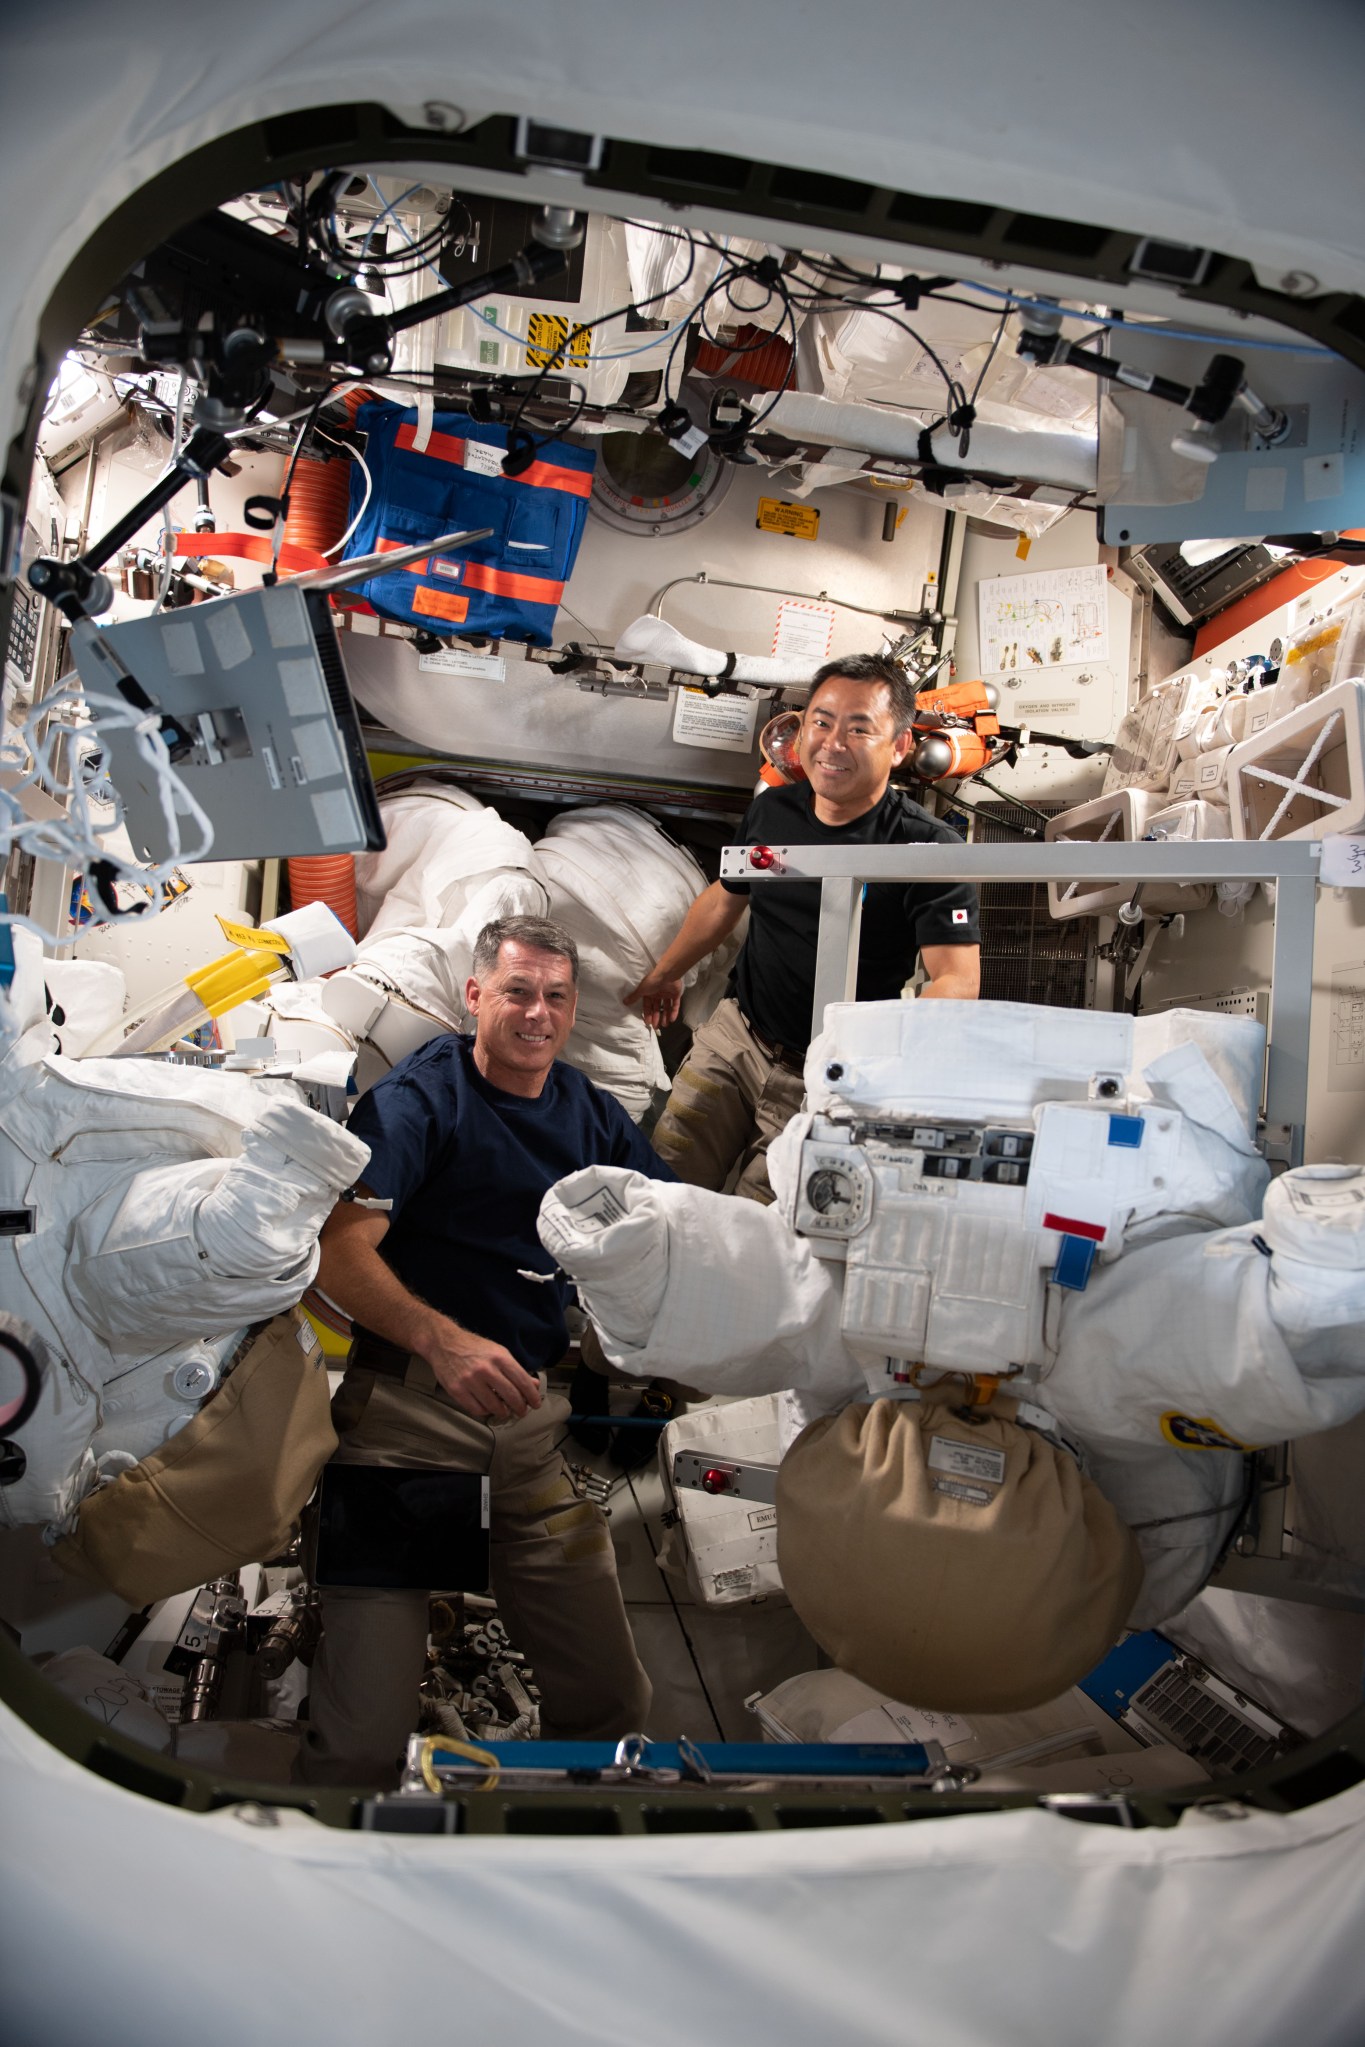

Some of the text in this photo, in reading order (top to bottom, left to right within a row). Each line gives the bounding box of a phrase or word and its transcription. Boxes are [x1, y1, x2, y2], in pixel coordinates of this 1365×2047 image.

[774, 507, 804, 518] WARNING
[756, 1513, 772, 1523] EMU
[255, 1608, 273, 1616] 3
[184, 1635, 201, 1648] 5
